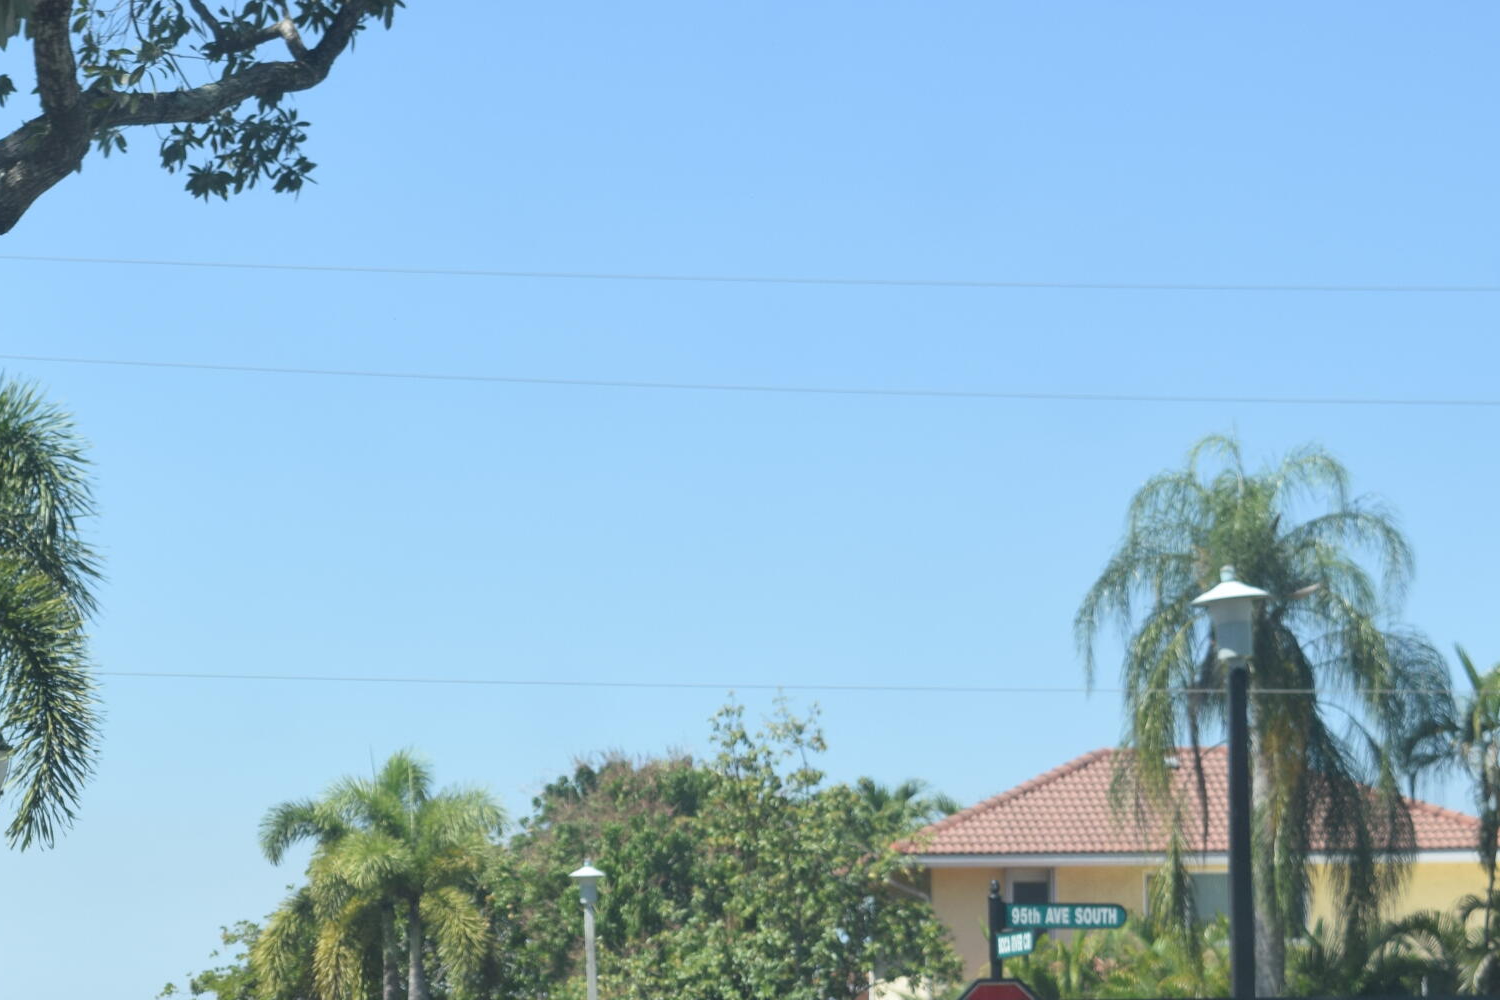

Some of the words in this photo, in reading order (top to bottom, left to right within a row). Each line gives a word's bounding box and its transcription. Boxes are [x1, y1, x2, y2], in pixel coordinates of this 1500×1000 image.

[1011, 907, 1041, 925] 95th
[1044, 907, 1069, 925] AVE
[1074, 907, 1117, 925] SOUTH
